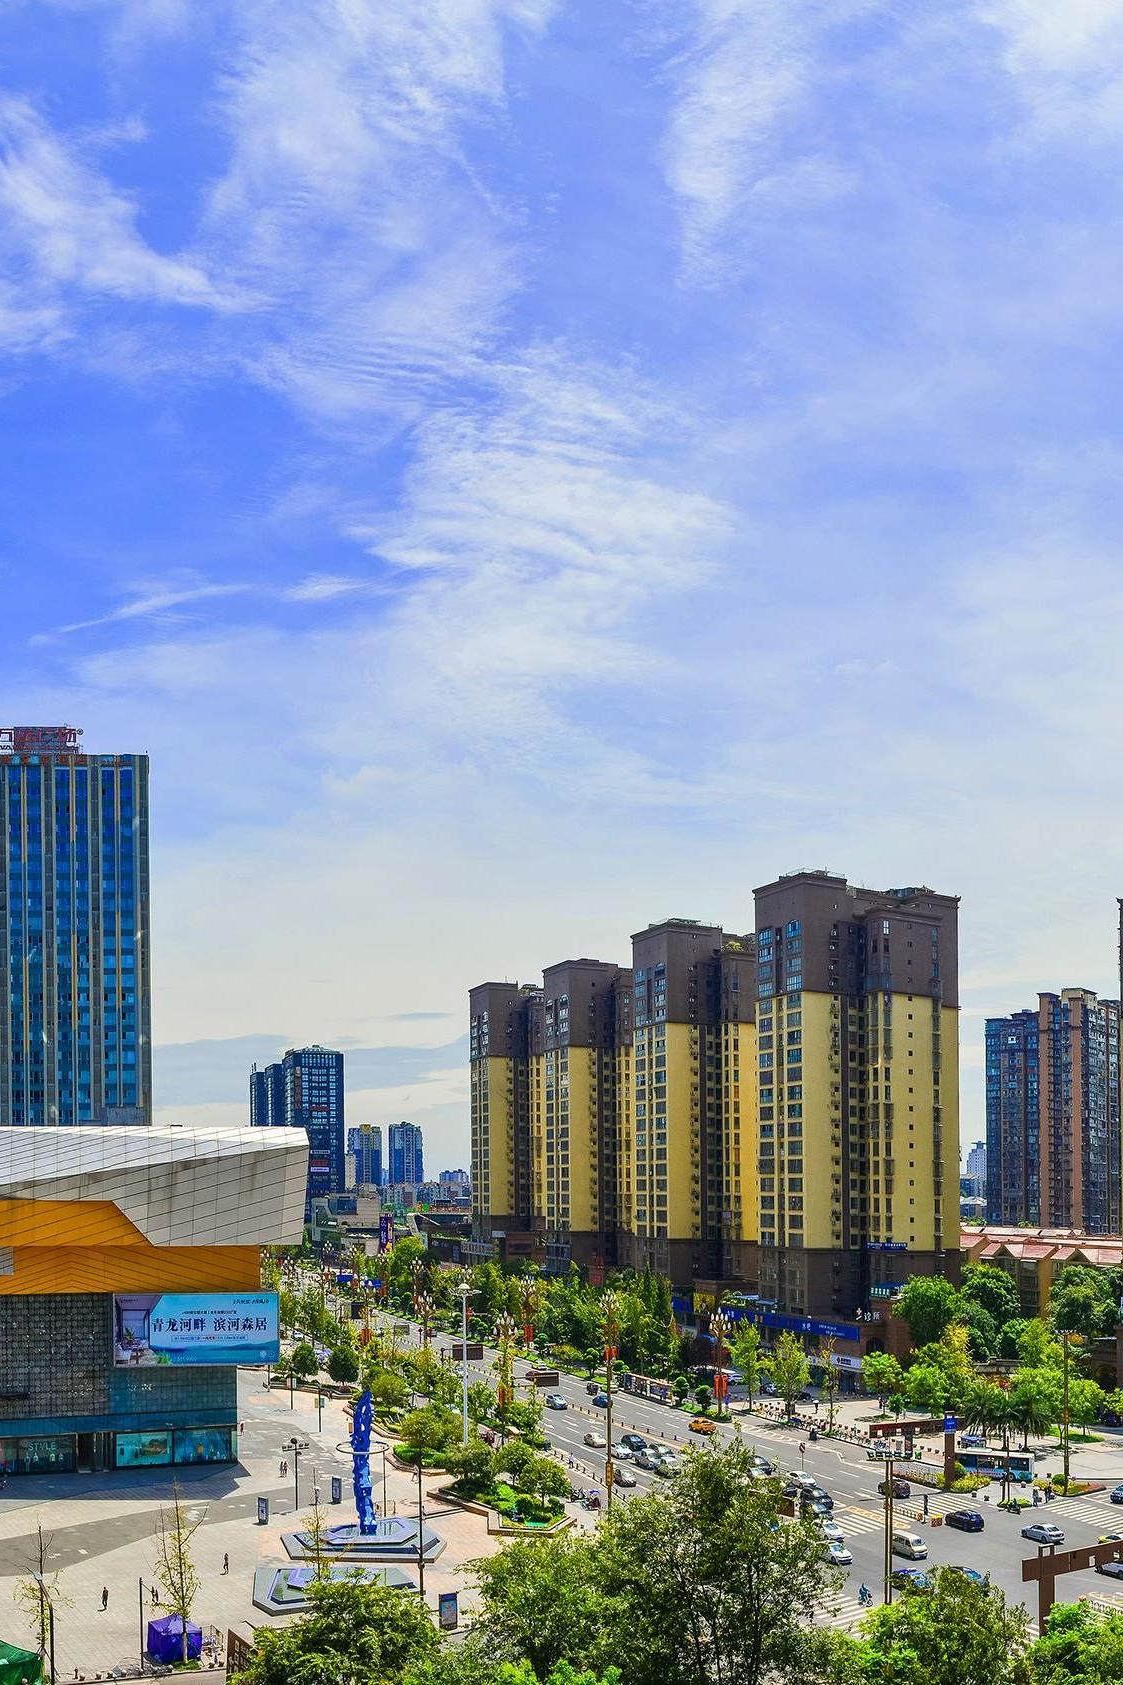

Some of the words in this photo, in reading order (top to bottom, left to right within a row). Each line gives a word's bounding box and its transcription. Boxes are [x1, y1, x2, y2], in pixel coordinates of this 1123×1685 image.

[151, 1317, 206, 1333] 青龙河畔
[213, 1316, 268, 1332] 滨河森居
